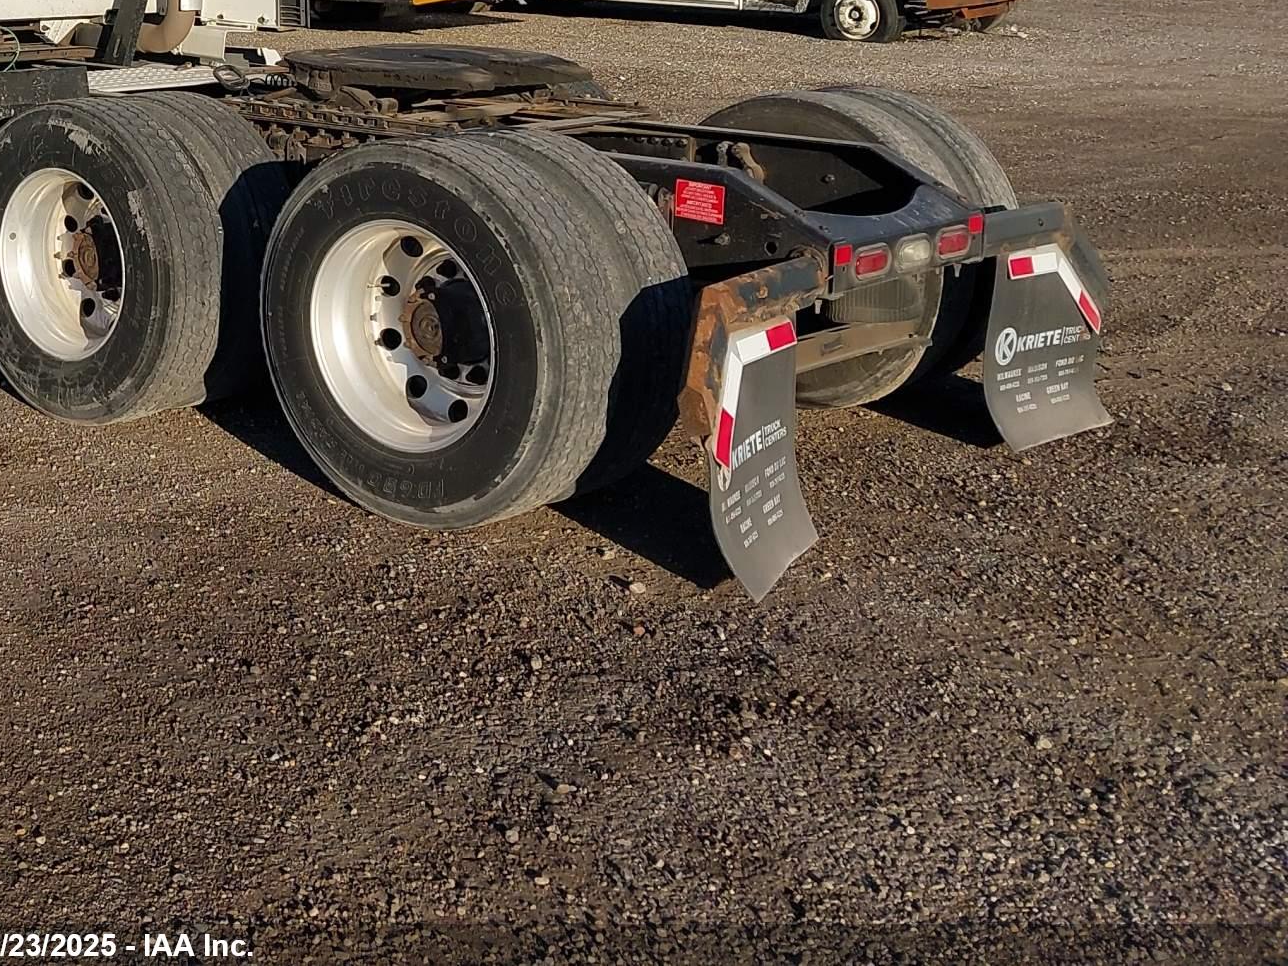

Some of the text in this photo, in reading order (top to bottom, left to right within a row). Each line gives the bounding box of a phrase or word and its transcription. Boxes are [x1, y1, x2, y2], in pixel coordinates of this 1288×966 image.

[1016, 325, 1085, 353] KRIETE TRUC
[732, 419, 781, 471] KRIETE TRUCK
